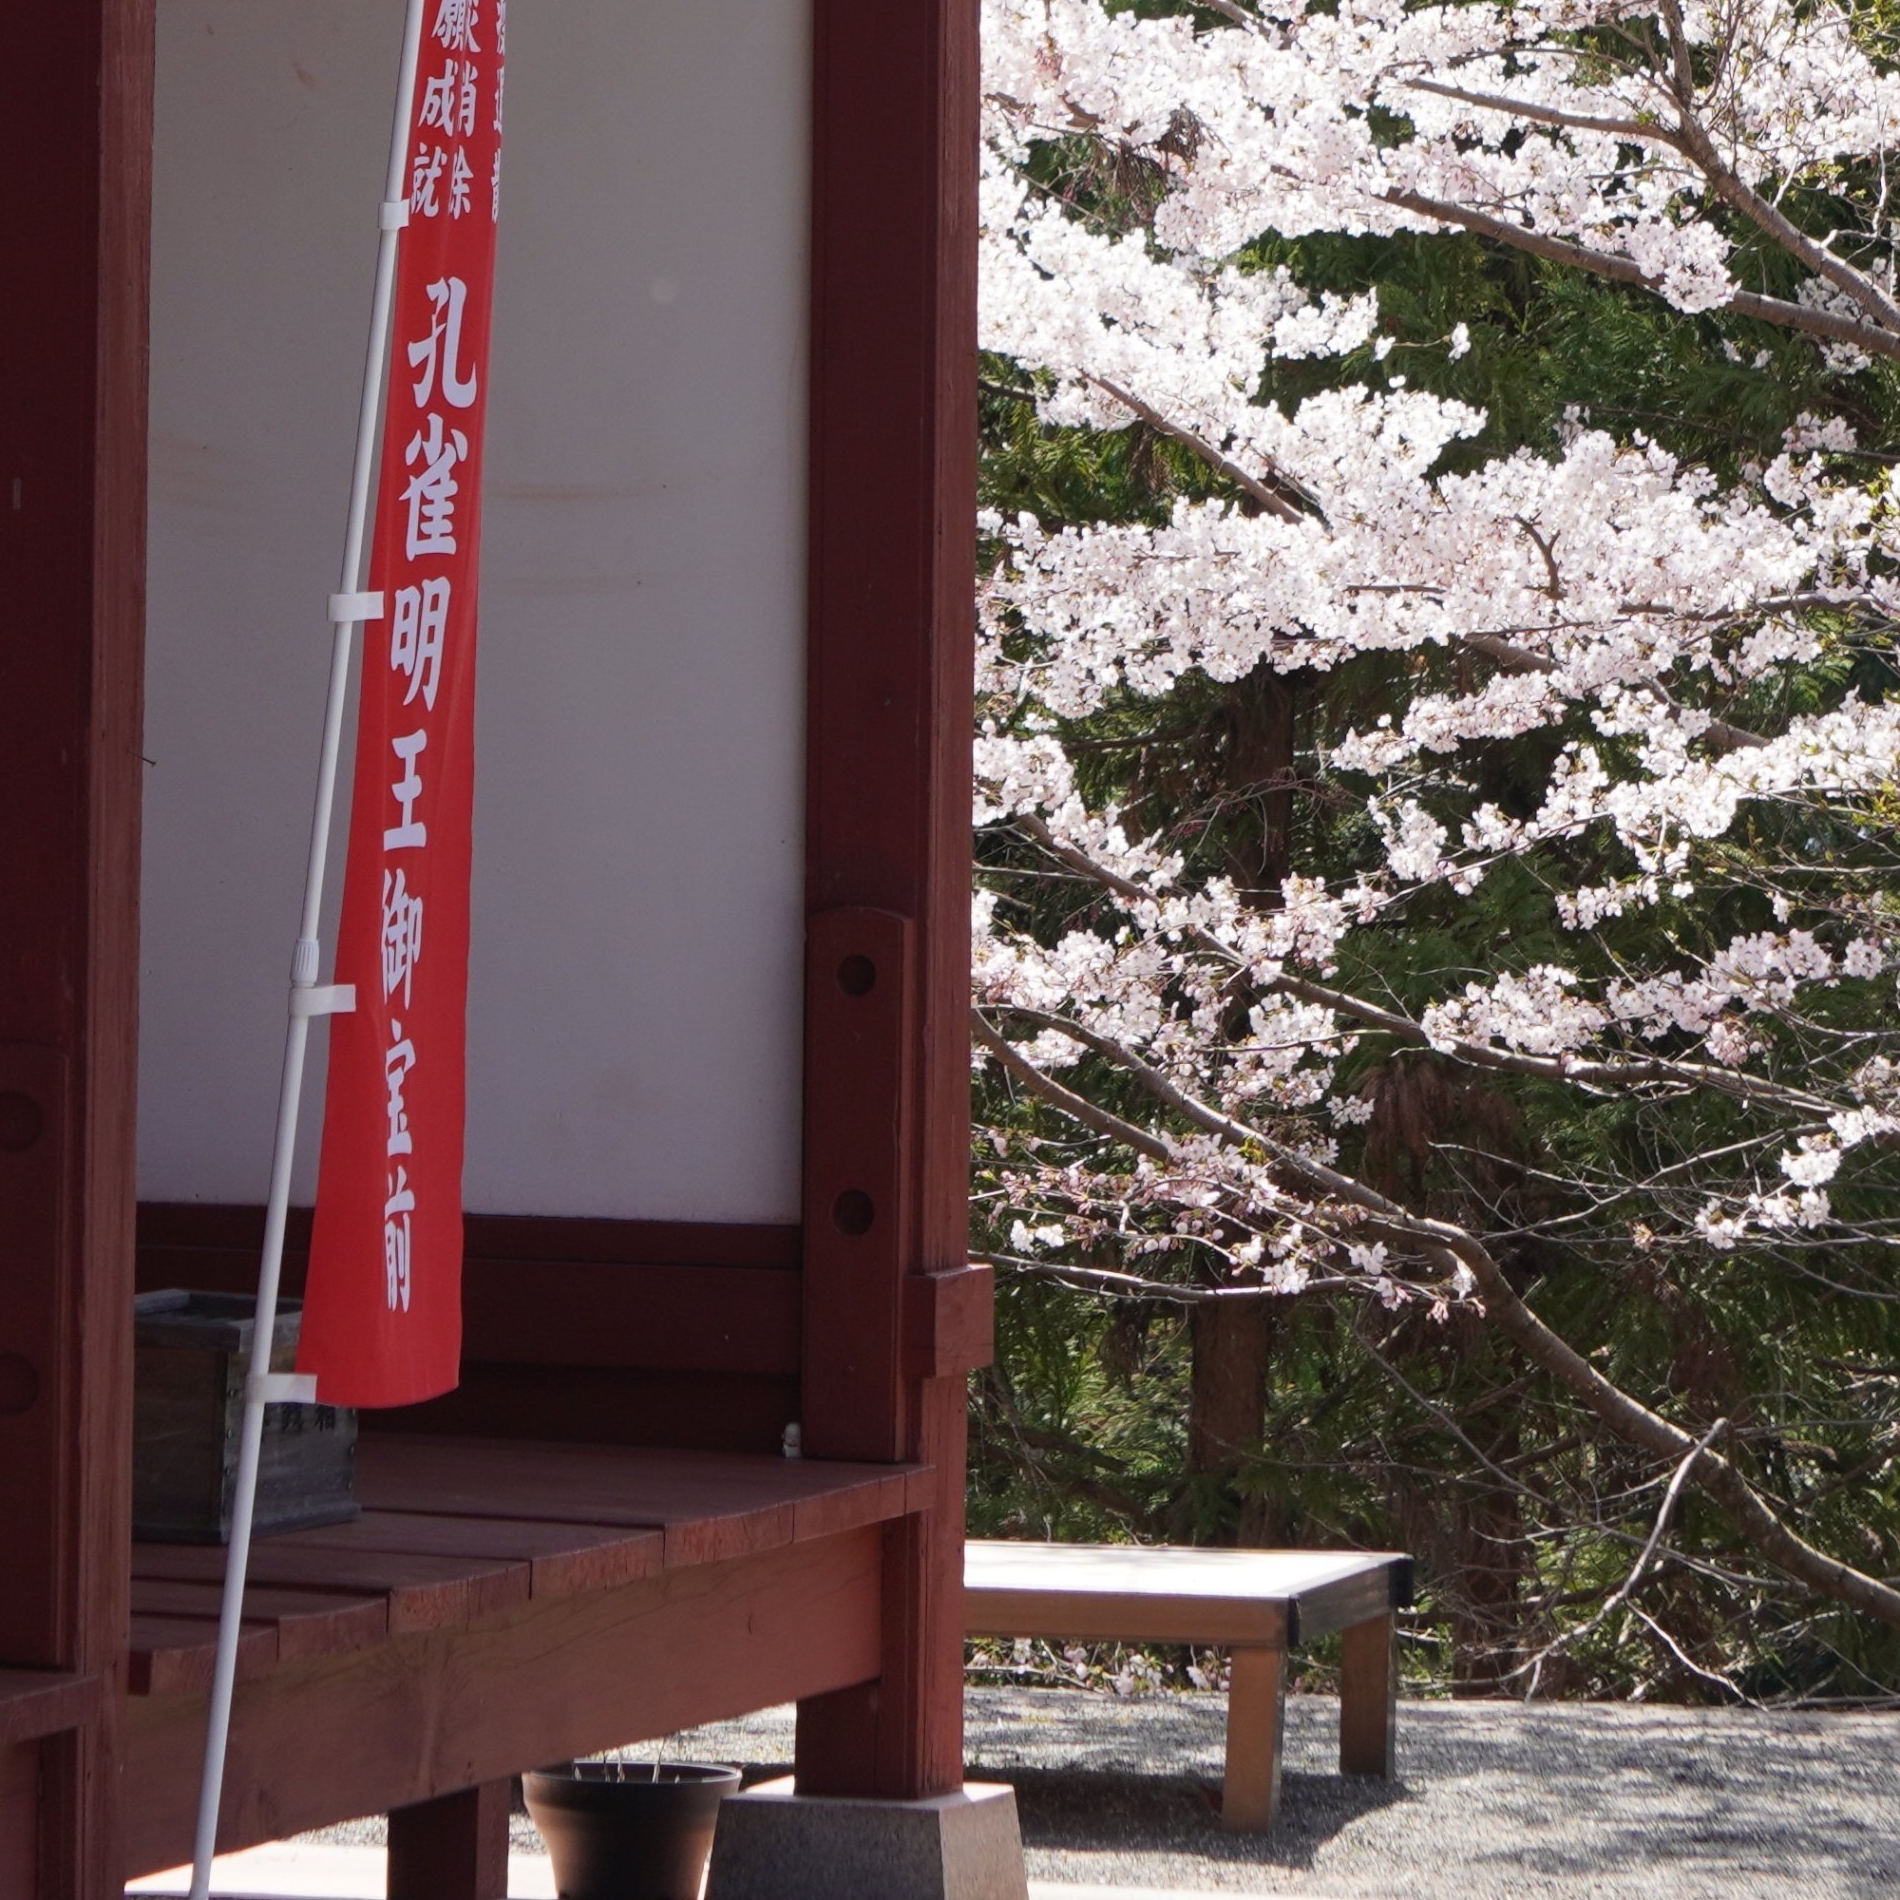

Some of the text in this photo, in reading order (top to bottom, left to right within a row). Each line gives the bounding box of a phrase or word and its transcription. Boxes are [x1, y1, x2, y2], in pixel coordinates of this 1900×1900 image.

[380, 277, 476, 1313] 孔雀明王御宝前
